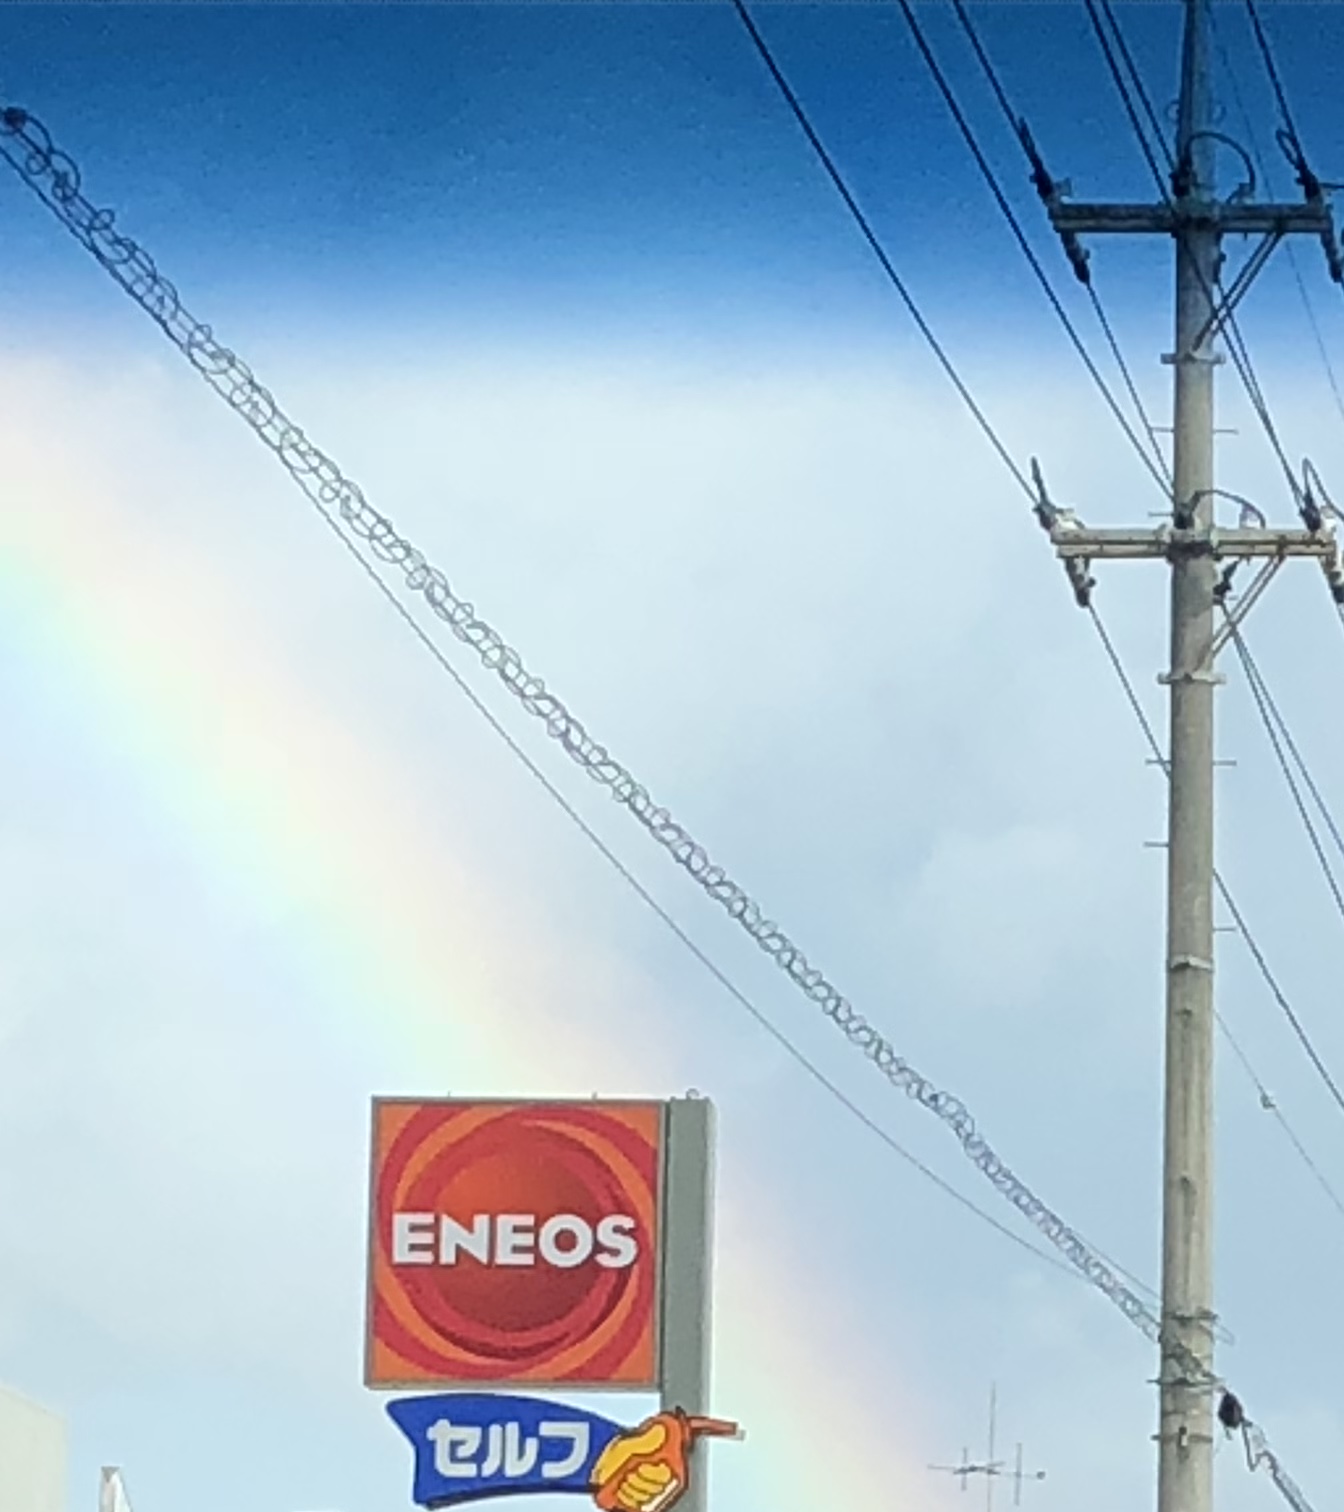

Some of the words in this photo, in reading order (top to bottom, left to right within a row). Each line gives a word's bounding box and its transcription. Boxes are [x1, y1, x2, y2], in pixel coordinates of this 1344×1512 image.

[391, 1211, 638, 1268] ENEOS
[426, 1419, 590, 1478] セルフ
